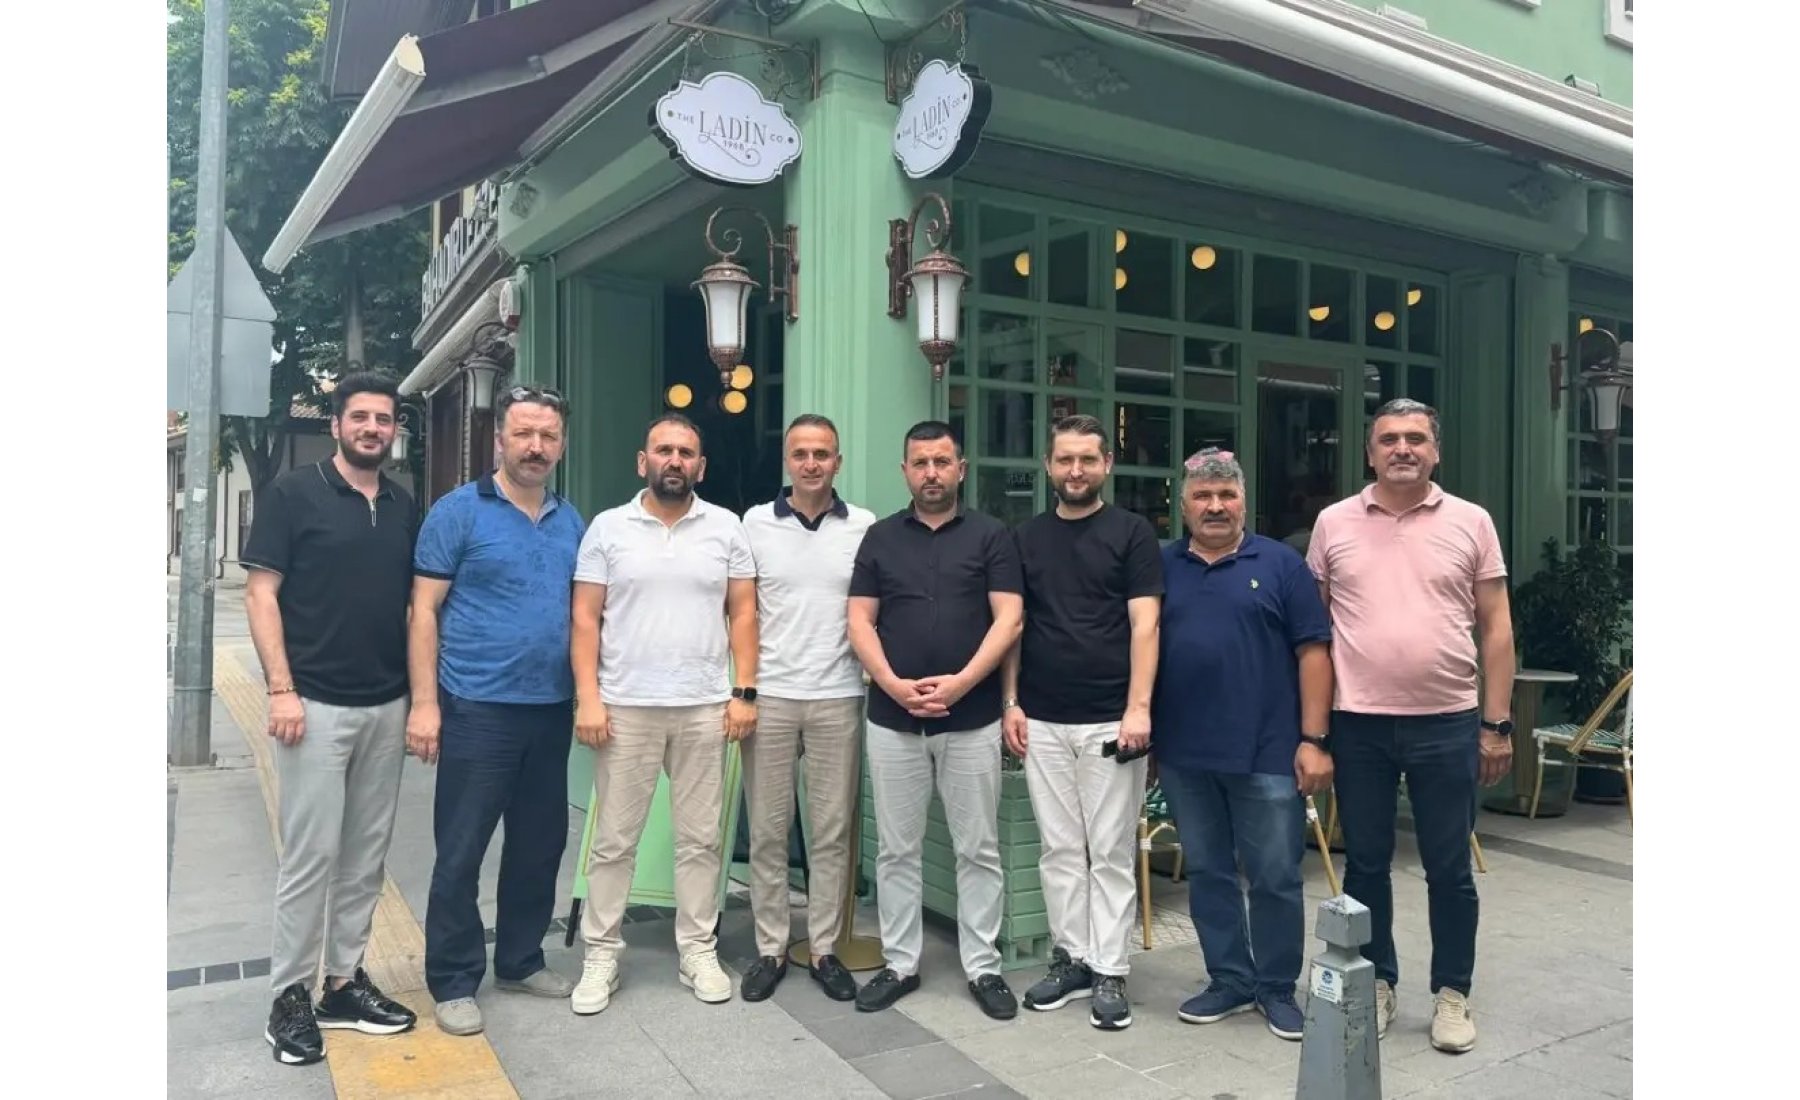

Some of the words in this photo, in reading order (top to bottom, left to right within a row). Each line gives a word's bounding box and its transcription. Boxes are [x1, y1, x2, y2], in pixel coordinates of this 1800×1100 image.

[676, 112, 695, 125] THE
[699, 110, 768, 147] LADİN
[913, 94, 951, 140] LADİN
